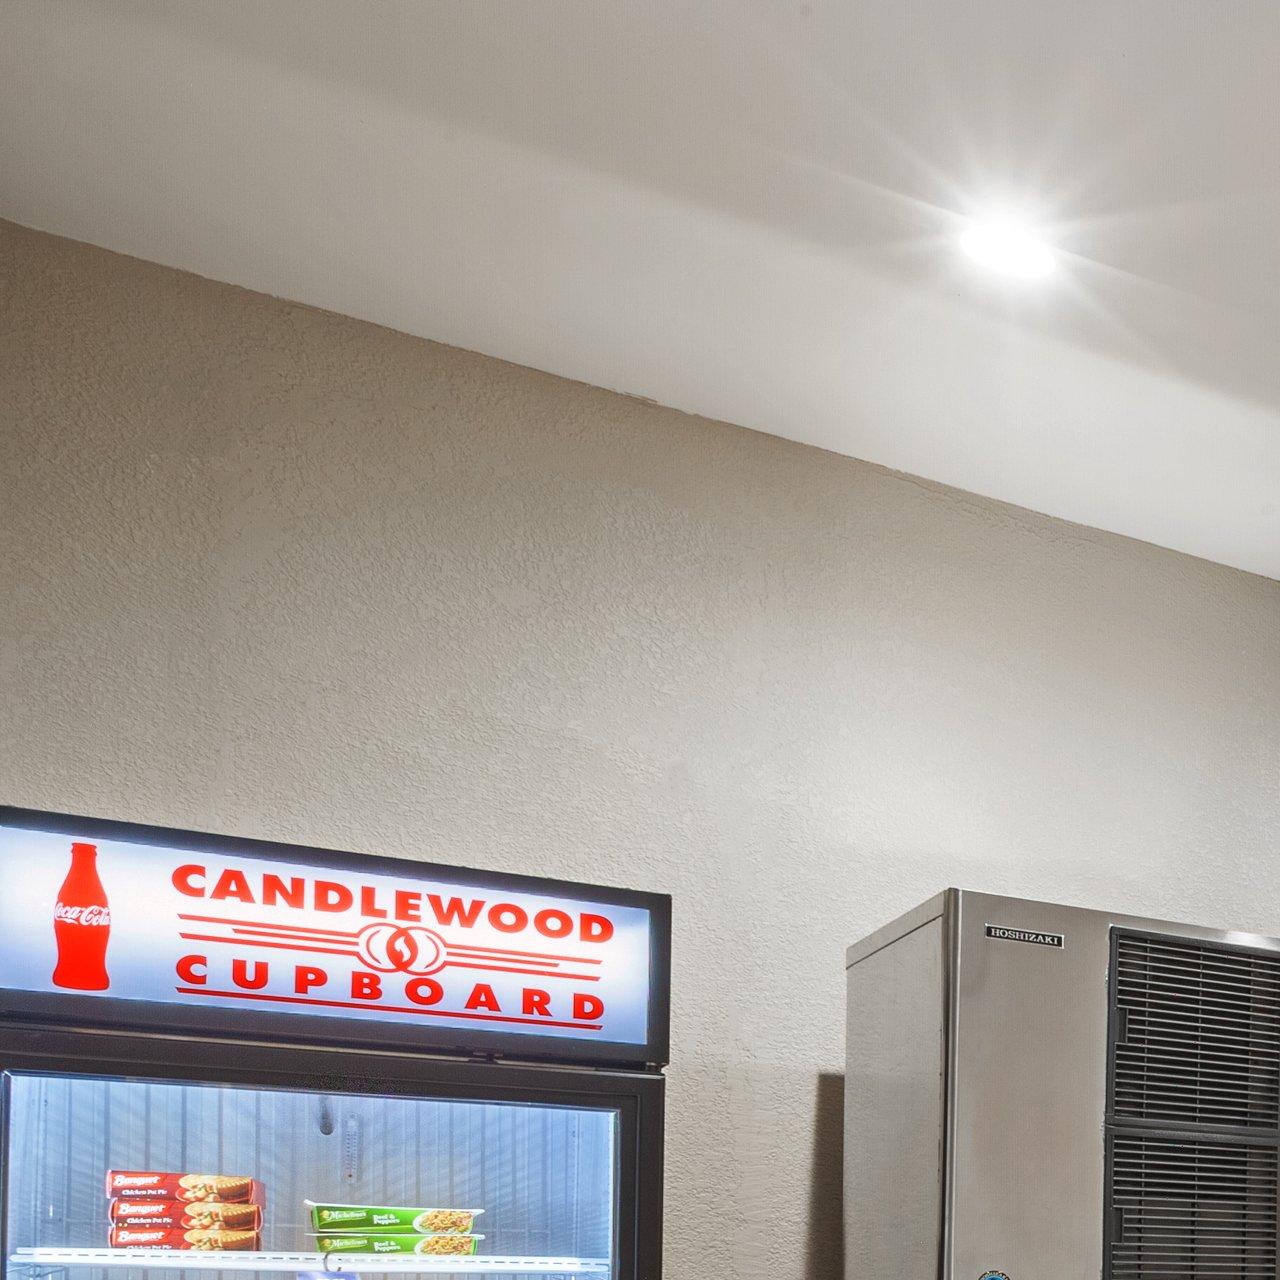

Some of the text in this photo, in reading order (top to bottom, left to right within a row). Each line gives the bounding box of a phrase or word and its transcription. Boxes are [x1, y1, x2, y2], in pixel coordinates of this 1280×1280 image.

[172, 864, 614, 942] CANDLEWOOD
[991, 927, 1059, 946] HOSHIZAKI
[176, 955, 605, 1021] CUPBOARD
